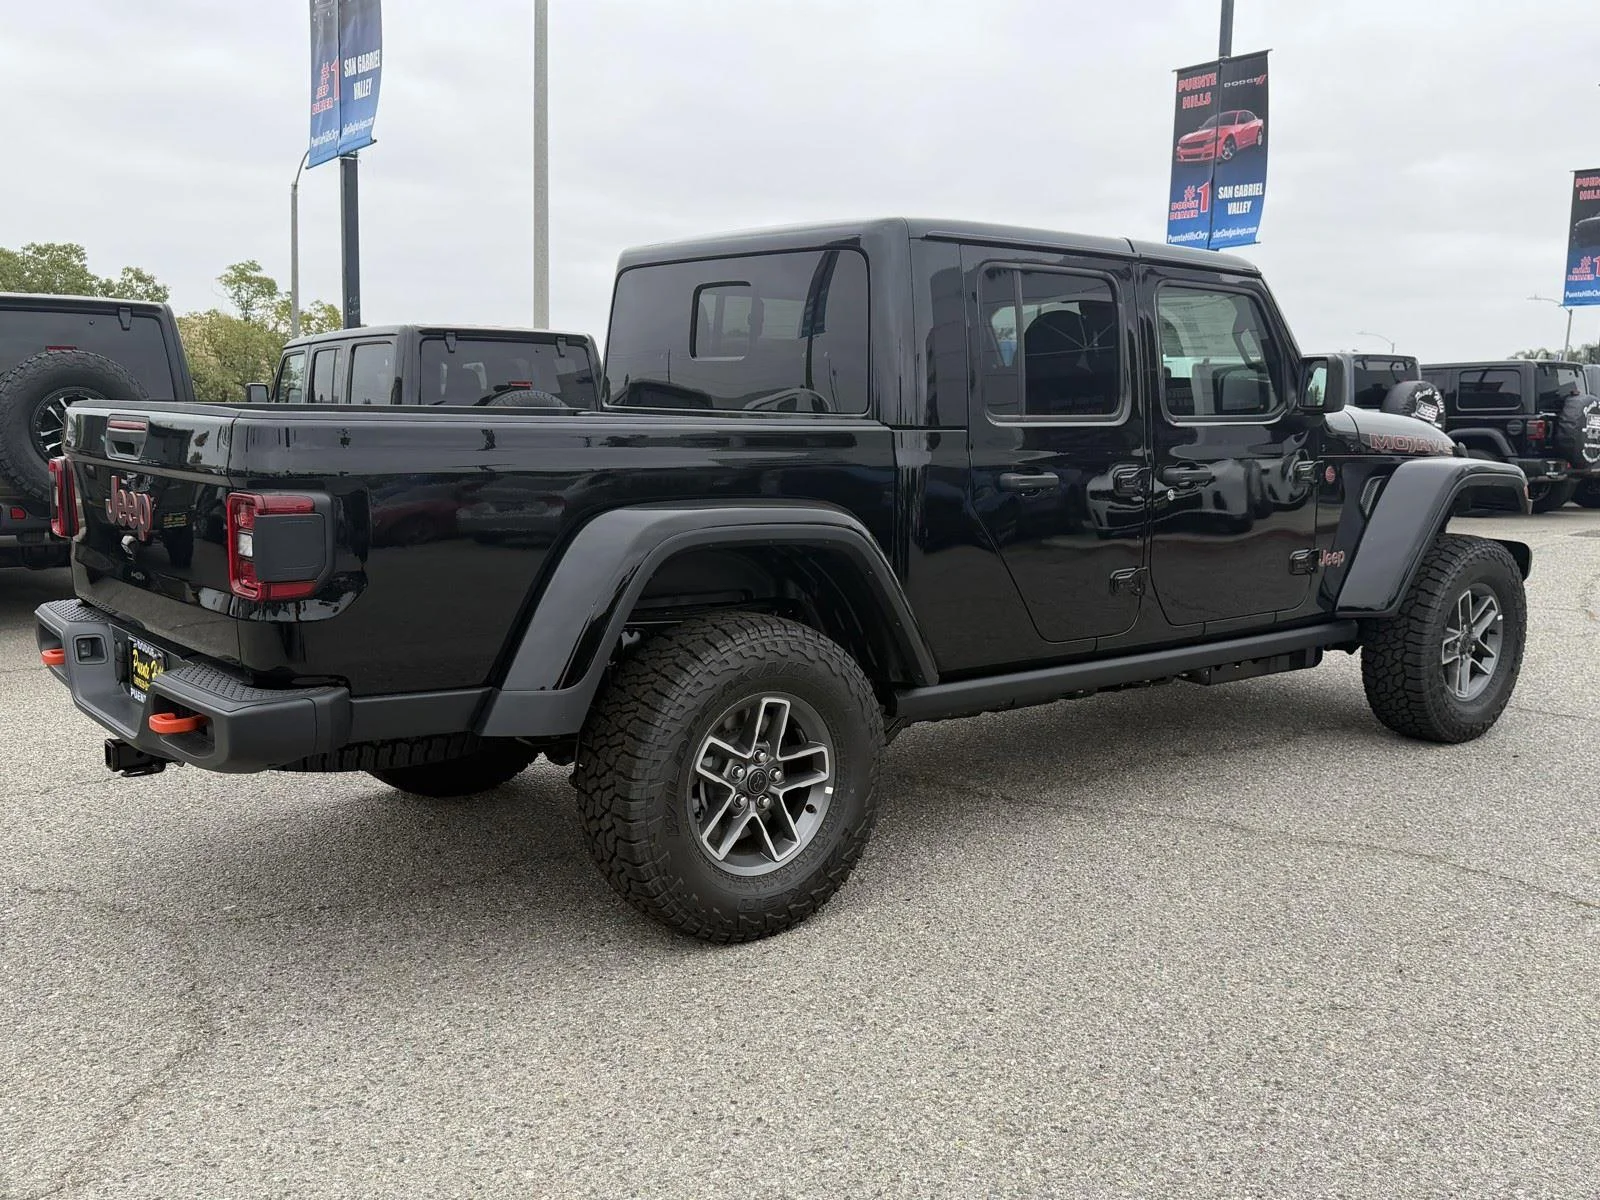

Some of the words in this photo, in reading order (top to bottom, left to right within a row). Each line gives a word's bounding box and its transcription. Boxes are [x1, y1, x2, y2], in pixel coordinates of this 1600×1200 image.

[344, 56, 357, 78] SAN
[357, 49, 381, 74] GABRIEL
[353, 77, 373, 101] VALLEY
[1178, 72, 1217, 92] PUENTE
[1182, 92, 1212, 110] HILLS
[1218, 186, 1233, 200] SAN
[1233, 182, 1264, 199] GABRIEL
[1227, 200, 1253, 216] VALLEY
[104, 475, 152, 542] Jeep
[1318, 549, 1345, 568] Jeep
